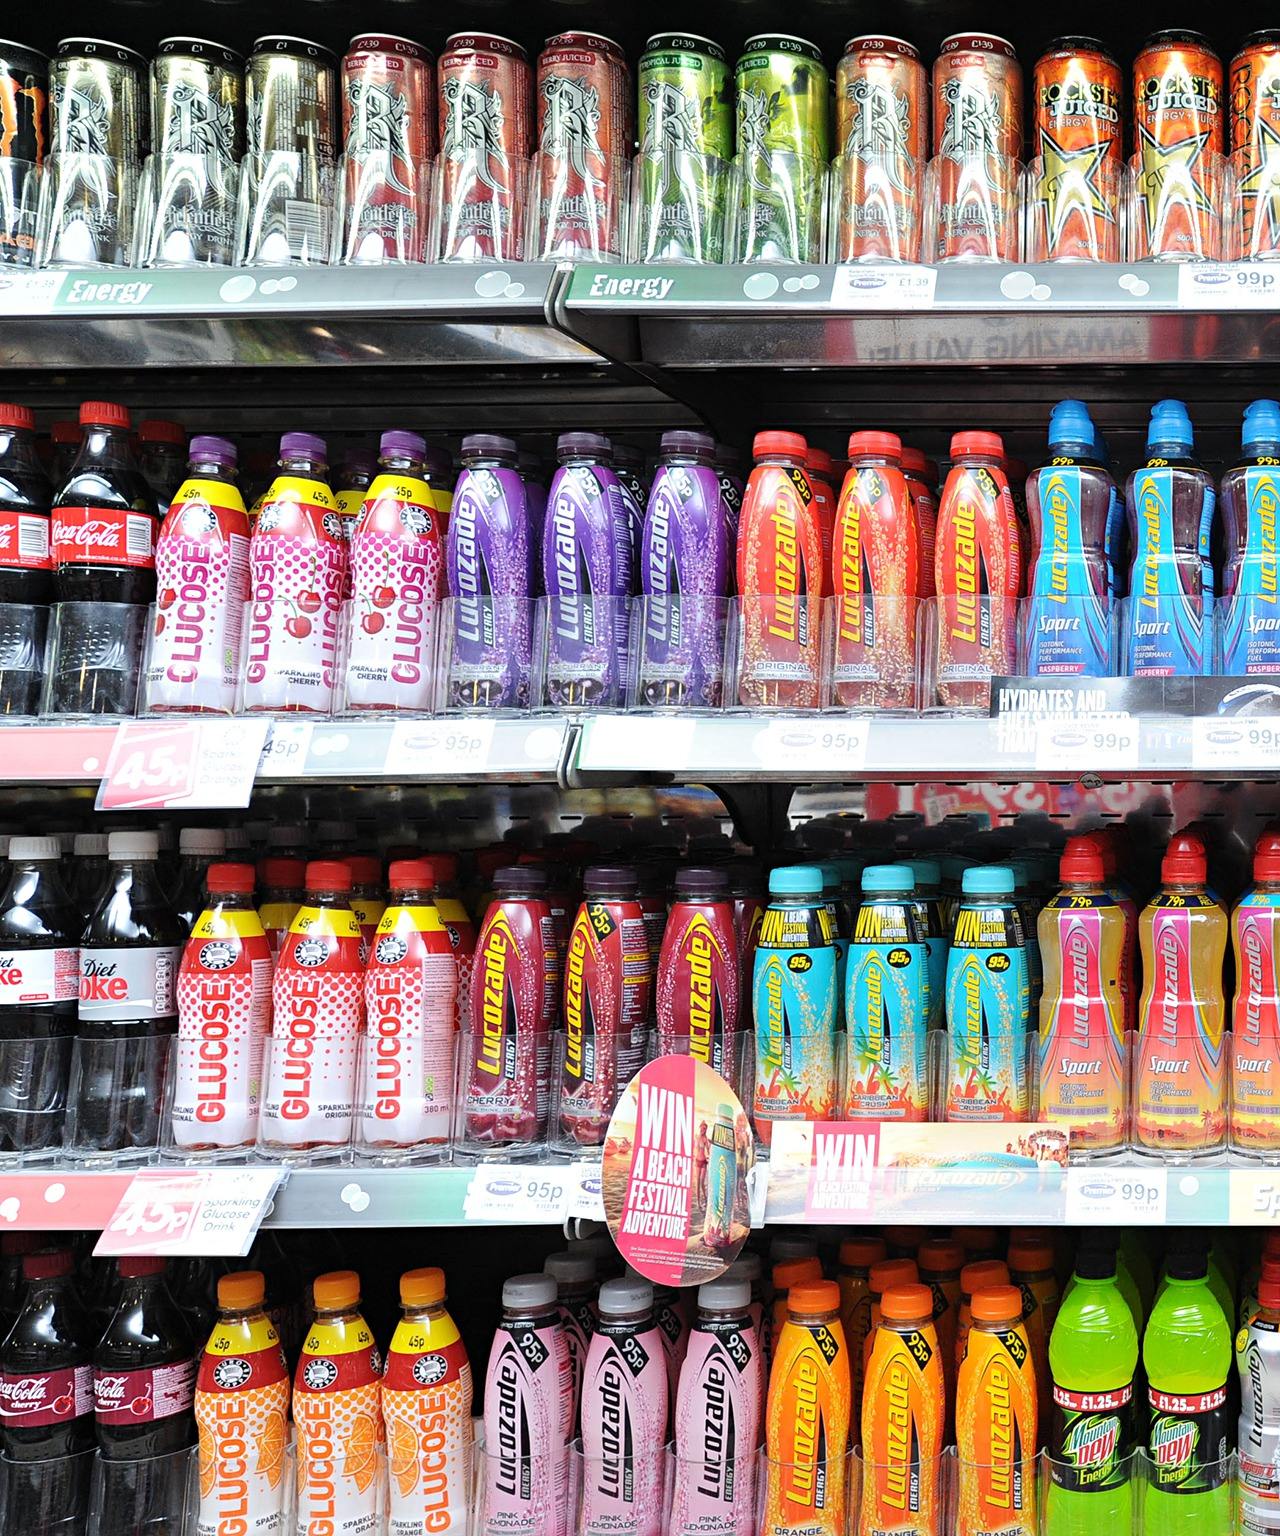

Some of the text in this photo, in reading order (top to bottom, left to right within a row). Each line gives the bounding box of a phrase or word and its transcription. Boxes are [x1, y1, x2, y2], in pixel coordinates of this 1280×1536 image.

[562, 54, 591, 64] JUICED
[1048, 99, 1118, 124] JUICED
[1147, 93, 1218, 115] JUICED
[67, 279, 152, 304] Energy
[590, 274, 673, 299] Energy
[899, 277, 929, 287] £1.39
[1237, 272, 1275, 287] 99p
[1048, 495, 1068, 604] Lucozade
[1141, 497, 1160, 609] Lucozade
[1258, 496, 1277, 604] Lucozade
[455, 501, 480, 643] Lucozade
[554, 499, 579, 642] Lucozade
[646, 498, 670, 642] Lucozade
[769, 504, 797, 641] Lucozade
[840, 500, 861, 643] Lucozade
[951, 504, 977, 643] Lucozade
[247, 543, 275, 684] GLUCOSE
[390, 545, 431, 685] GLUCOSE
[484, 605, 494, 647] ENERGY
[584, 603, 593, 645] ENERGY
[671, 605, 681, 647] ENERGY
[757, 662, 810, 672] ORIGINAL
[1039, 665, 1079, 673] RASPBERRY
[999, 689, 1105, 711] HYDRATES AND
[262, 739, 299, 755] 45p
[446, 735, 482, 751] 95p
[821, 734, 859, 749] 95p
[1094, 732, 1131, 750] 99p
[113, 752, 188, 789] 45p
[1070, 896, 1092, 908] 79p
[1166, 896, 1186, 908] 79p
[591, 904, 611, 934] 95p
[790, 956, 810, 970] 95p
[889, 951, 910, 965] 95p
[988, 956, 1009, 970] 95p
[477, 933, 507, 1075] Lucozade
[565, 935, 586, 1076] Lucozade
[766, 971, 783, 1066] Lucozade
[196, 983, 231, 1123] GLUCOSE
[281, 979, 320, 1121] GLUCOSE
[375, 977, 401, 1120] GLUCOSE
[1058, 1058, 1101, 1076] Sport
[1149, 1056, 1190, 1074] Sport
[467, 1096, 511, 1106] CHERRY
[640, 1083, 693, 1156] WIN
[632, 1148, 691, 1188] A BEACH
[815, 1134, 875, 1181] WIN
[486, 1184, 563, 1203] Premier 95p
[628, 1180, 689, 1216] FESTIVAL
[1081, 1184, 1159, 1203] Premier 99p
[112, 1206, 190, 1236] 45p
[202, 1210, 250, 1221] Glucose
[203, 1222, 236, 1233] Drink
[622, 1210, 688, 1240] ADVENTURE
[409, 1336, 425, 1349] 45p
[519, 1333, 543, 1363] 95p
[622, 1338, 644, 1369] 95p
[726, 1333, 748, 1364] 95p
[1071, 1418, 1119, 1448] Mountain
[1153, 1422, 1196, 1450] Mountain
[216, 1400, 248, 1536] GLUCOSE
[419, 1394, 451, 1534] GLUCOSE
[497, 1511, 518, 1520] PINK
[600, 1515, 622, 1523] PINK
[699, 1515, 722, 1523] PINK
